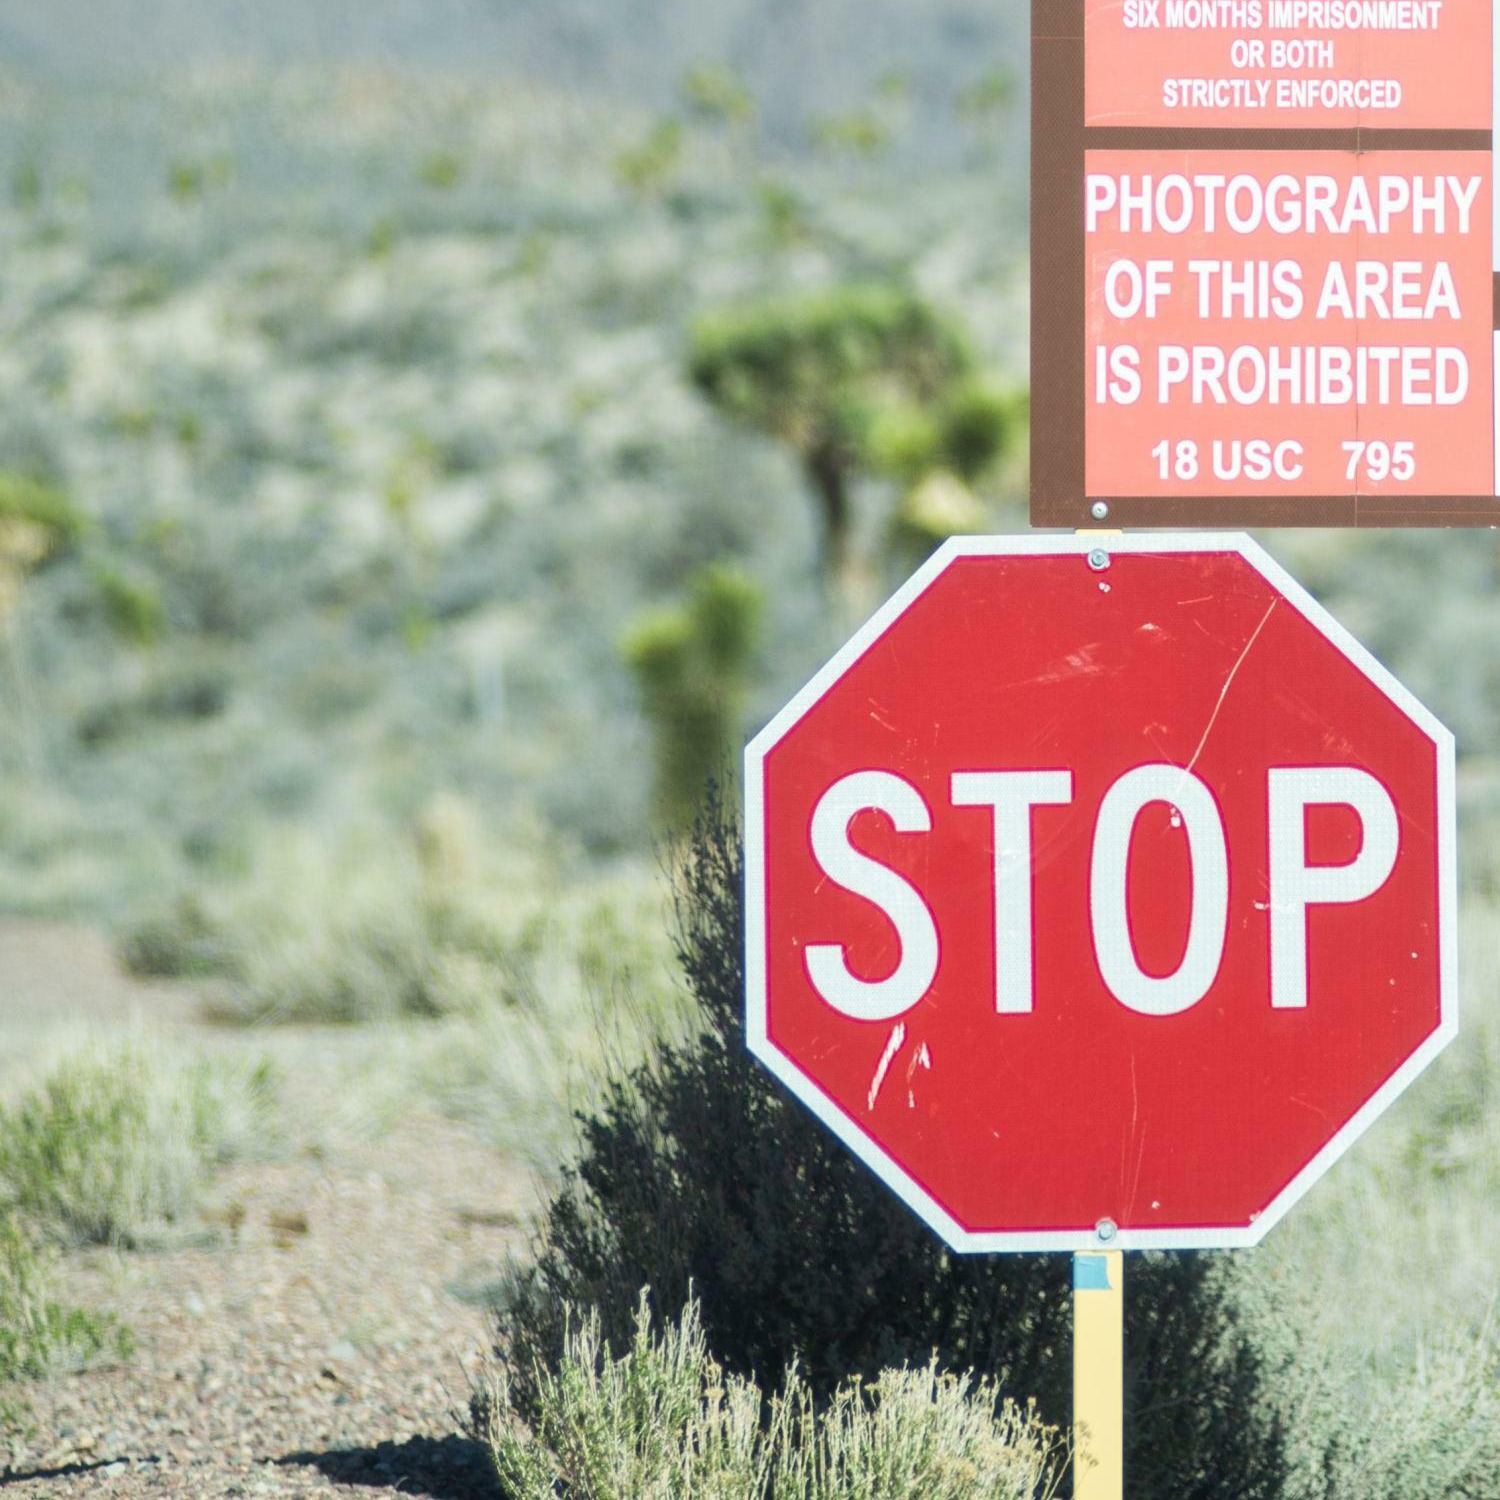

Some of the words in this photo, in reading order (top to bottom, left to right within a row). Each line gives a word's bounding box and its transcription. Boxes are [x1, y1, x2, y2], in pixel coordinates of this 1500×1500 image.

[1165, 0, 1263, 29] MONTHS
[1268, 0, 1443, 30] IMPRISONMENT
[1230, 39, 1266, 69] OR
[1270, 39, 1334, 69] BOTH
[1162, 78, 1272, 108] STRICTLY
[1276, 79, 1402, 109] ENFORCED
[1086, 174, 1482, 234] PHOTOGRAPHY
[1104, 258, 1174, 319] OF
[1188, 259, 1304, 320] THIS
[1315, 260, 1462, 320] AREA
[1095, 344, 1141, 405] IS
[1158, 345, 1469, 405] PROHIBITED
[1151, 439, 1199, 480] 18
[1212, 439, 1304, 481] USC
[1341, 440, 1416, 481] 795
[805, 765, 1399, 1020] STOP
